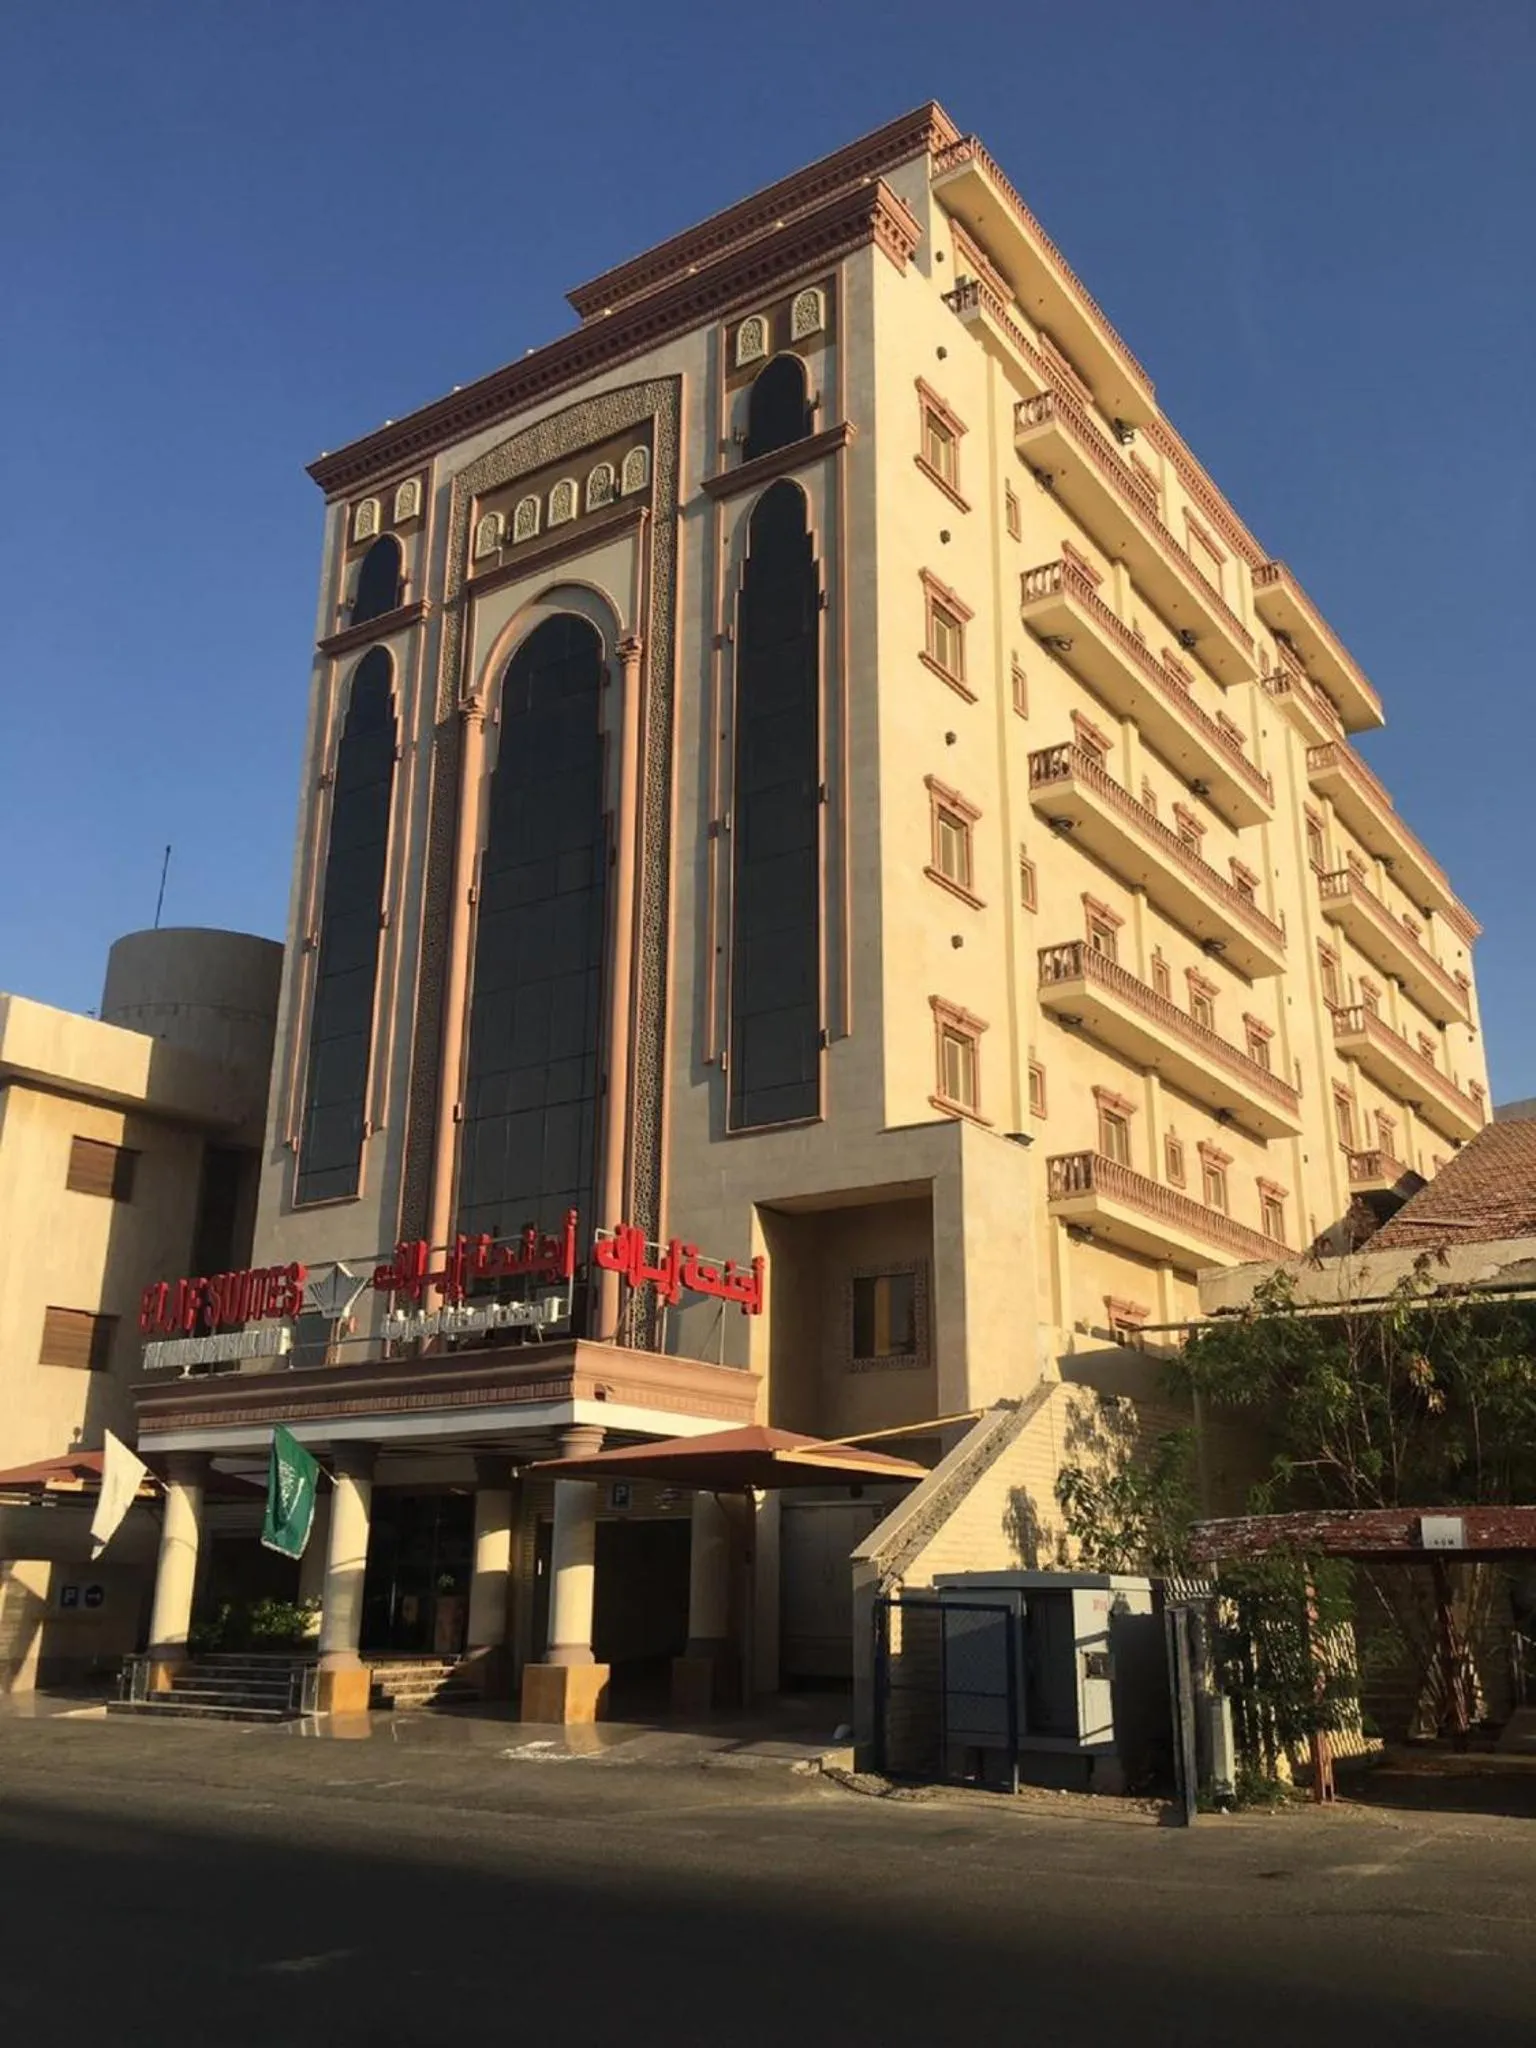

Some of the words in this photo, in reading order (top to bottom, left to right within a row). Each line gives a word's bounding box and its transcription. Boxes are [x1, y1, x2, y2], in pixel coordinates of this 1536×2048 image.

[138, 1276, 208, 1334] ELAF
[203, 1261, 308, 1328] SUITES
[679, 1243, 764, 1315] أجنحة
